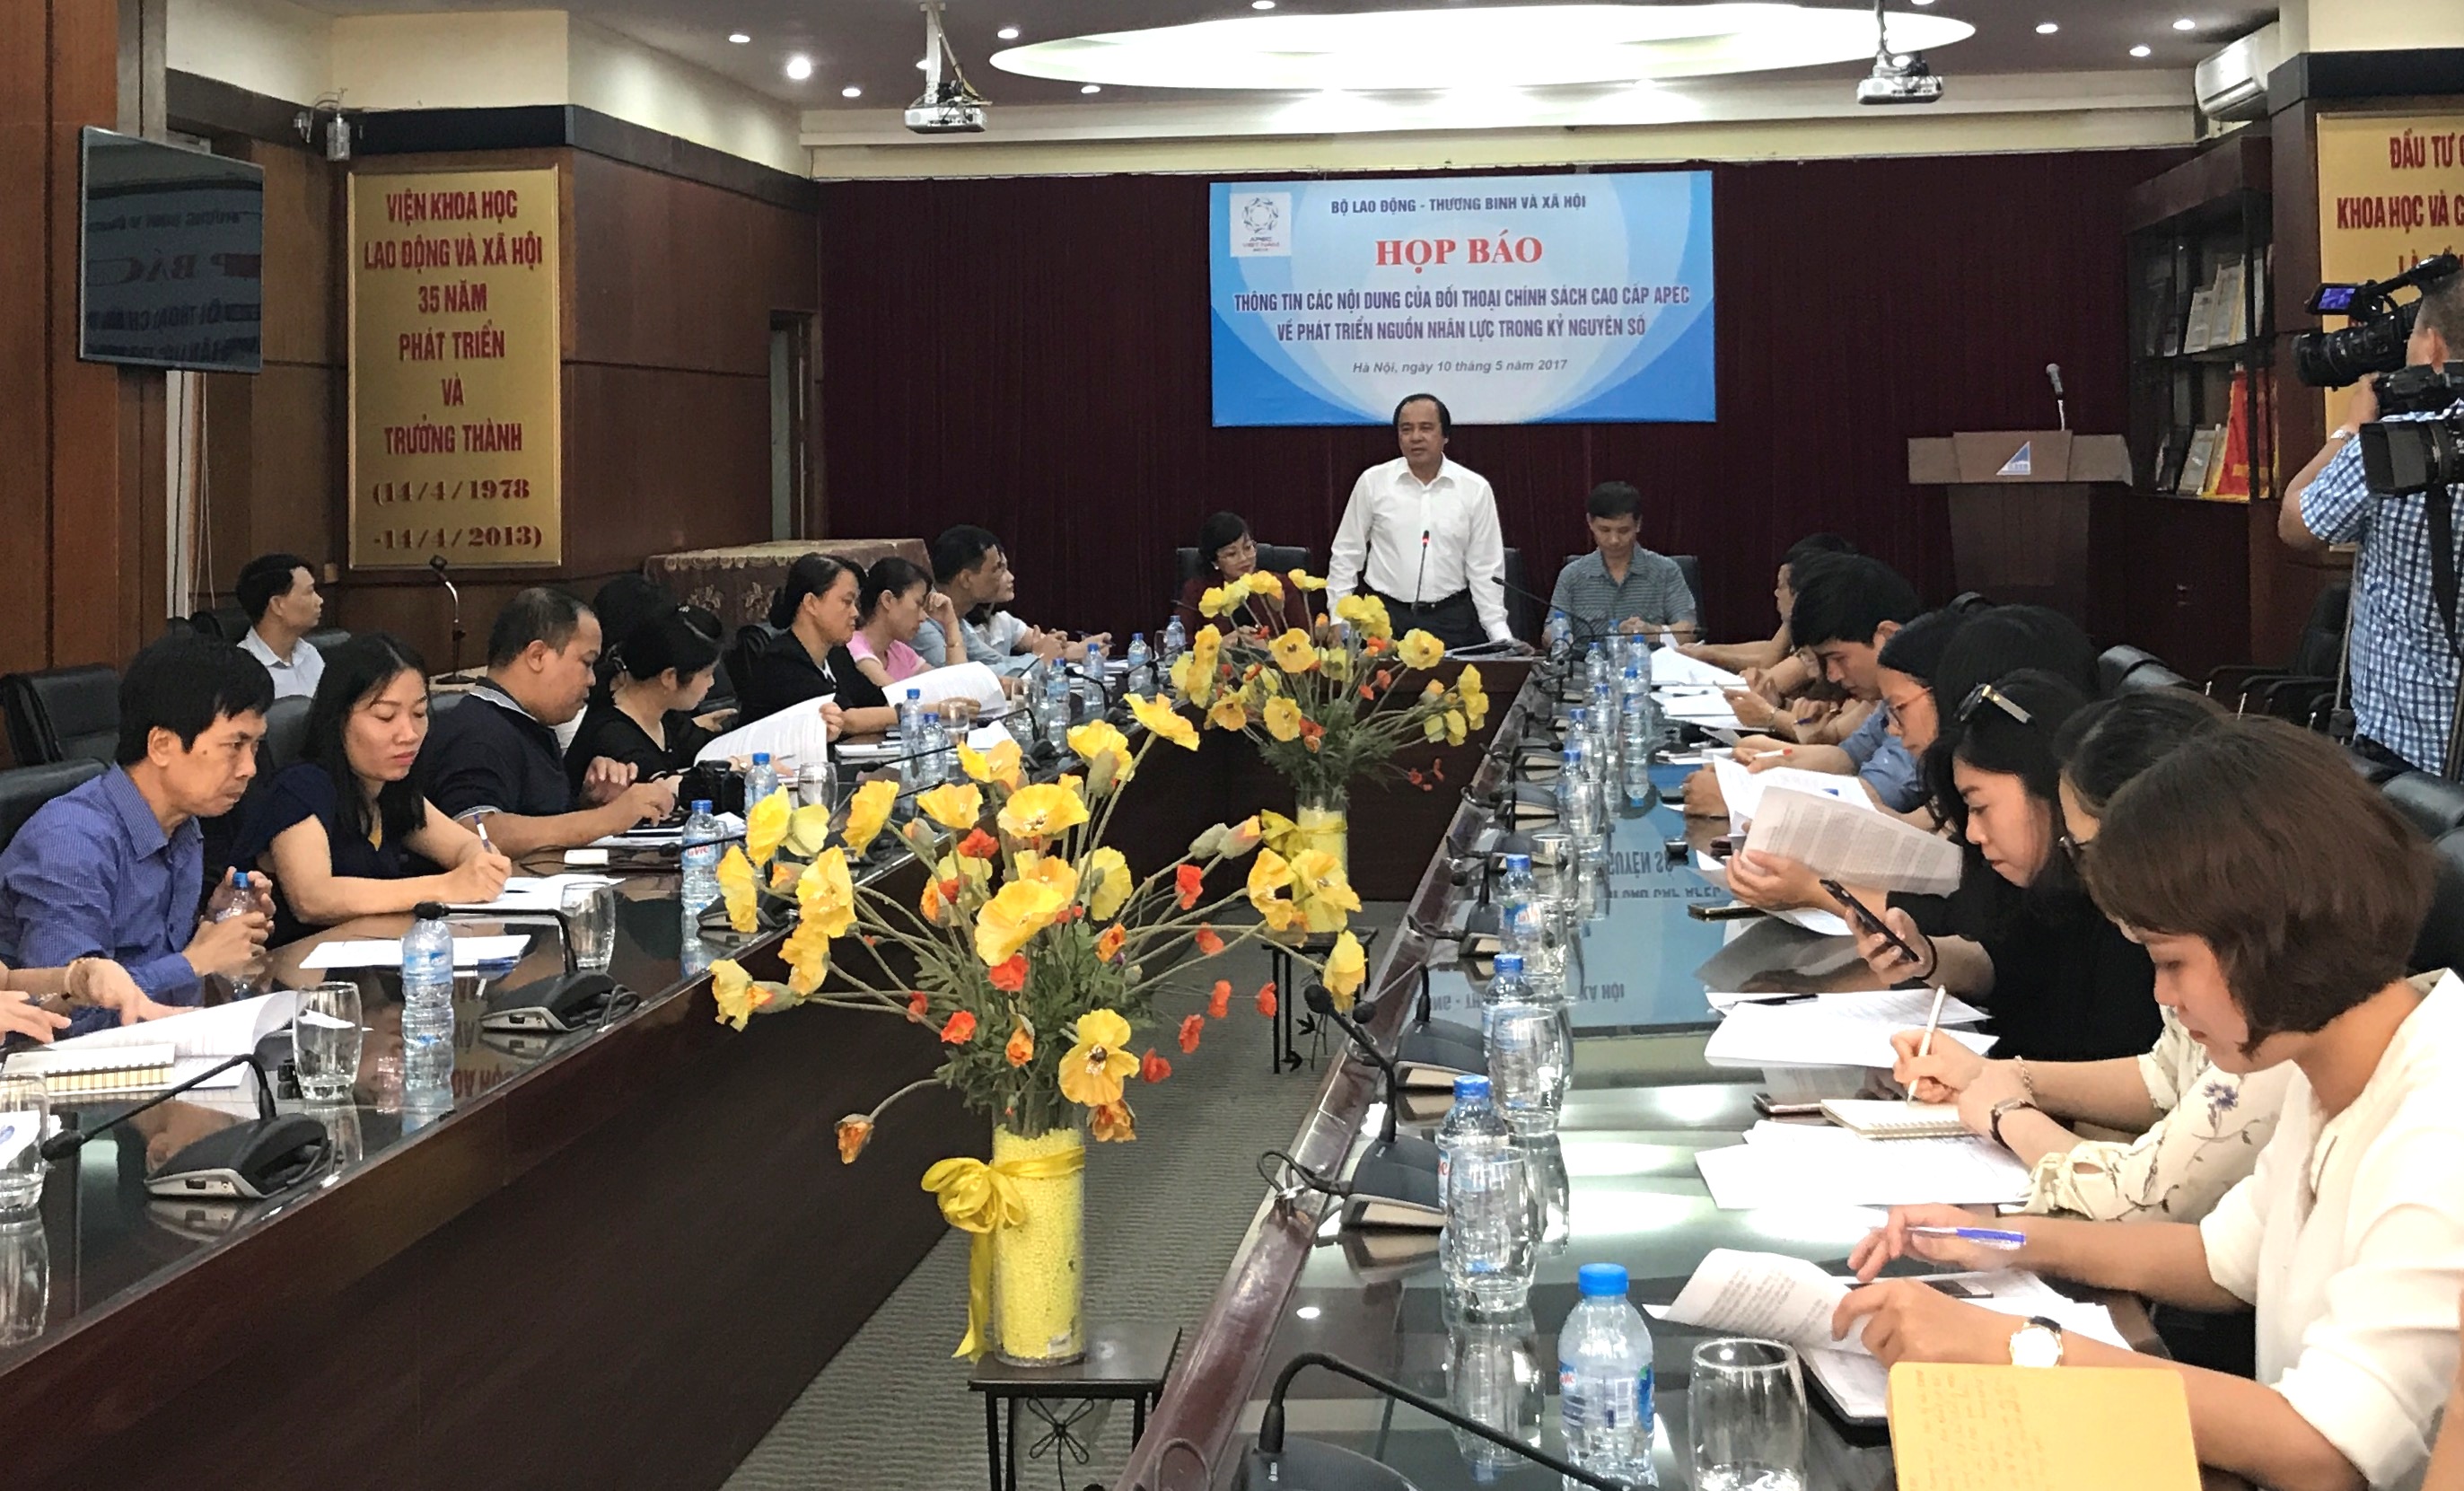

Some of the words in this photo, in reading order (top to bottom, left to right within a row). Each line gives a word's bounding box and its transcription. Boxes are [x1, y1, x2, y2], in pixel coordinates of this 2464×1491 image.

[2431, 132, 2456, 168] TƯ
[386, 188, 426, 226] VIỆN
[430, 191, 478, 221] KHOA
[481, 189, 518, 224] HỌC
[1330, 198, 1349, 216] BỘ
[1352, 199, 1377, 214] LAO
[1380, 197, 1416, 215] ĐỘNG
[1429, 197, 1481, 212] THƯƠNG
[1485, 197, 1517, 211] BINH
[1521, 193, 1539, 209] VÀ
[1542, 193, 1560, 209] XÃ
[1564, 193, 1587, 211] HỘI
[2337, 196, 2386, 229] KHOA
[2389, 194, 2425, 233] HỌC
[2427, 189, 2450, 226] VÀ
[364, 241, 397, 269] LAO
[401, 233, 451, 274] ĐỘNG
[454, 232, 478, 267] VÀ
[483, 232, 508, 266] XÃ
[512, 230, 543, 271] HỘI
[1375, 238, 1456, 274] HỌP
[1467, 229, 1544, 264] BÁO
[418, 285, 440, 313] 35
[444, 279, 487, 312] NĂM
[1234, 290, 1277, 311] THÔNG
[1282, 293, 1302, 311] TIN
[1307, 289, 1333, 311] CÁC
[1337, 289, 1360, 313] NỘI
[1364, 291, 1400, 310] DUNG
[1405, 285, 1432, 309] CỦA
[1435, 285, 1458, 308] ĐỐI
[1462, 288, 1501, 311] THOẠI
[1505, 285, 1547, 307] CHÍNH
[1551, 285, 1587, 306] SÁCH
[1592, 286, 1618, 305] CAO
[1622, 282, 1649, 305] CẤP
[1654, 285, 1690, 304] APEC
[399, 327, 445, 362] PHÁT
[452, 319, 504, 359] TRIỂN
[1277, 318, 1293, 341] VỀ
[1297, 320, 1330, 341] PHÁT
[1335, 316, 1373, 340] TRIỂN
[1377, 316, 1424, 340] NGUỒN
[1427, 317, 1465, 339] NHÂN
[1469, 319, 1494, 342] LỰC
[1499, 319, 1543, 338] TRONG
[1547, 313, 1564, 337] KỶ
[1568, 314, 1623, 337] NGUYÊN
[1627, 312, 1645, 336] SỐ
[1353, 362, 1370, 373] Hà
[1402, 362, 1434, 374] ngày
[1437, 361, 1452, 373] 10
[1455, 360, 1491, 373] tháng
[1495, 360, 1503, 371] 5
[1506, 360, 1533, 371] năm
[1538, 359, 1568, 371] 2017
[442, 372, 464, 406] VÀ
[384, 414, 456, 455] TRƯỞNG
[462, 417, 522, 452] THÀNH
